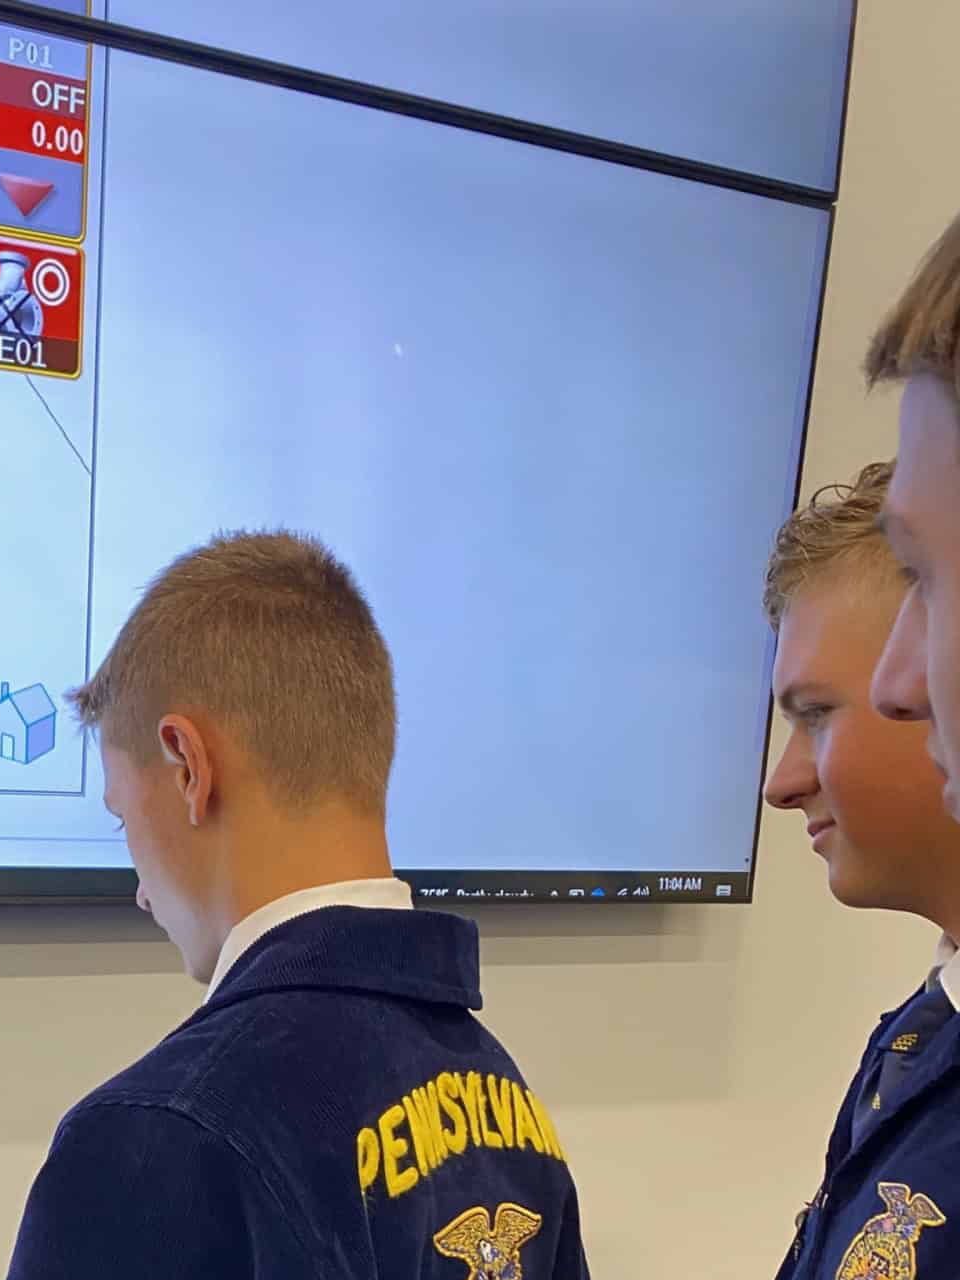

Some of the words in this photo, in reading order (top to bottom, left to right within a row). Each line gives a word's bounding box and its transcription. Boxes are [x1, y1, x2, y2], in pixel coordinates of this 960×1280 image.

[8, 37, 53, 69] P01
[31, 80, 85, 113] OFF
[31, 121, 84, 154] 0.00
